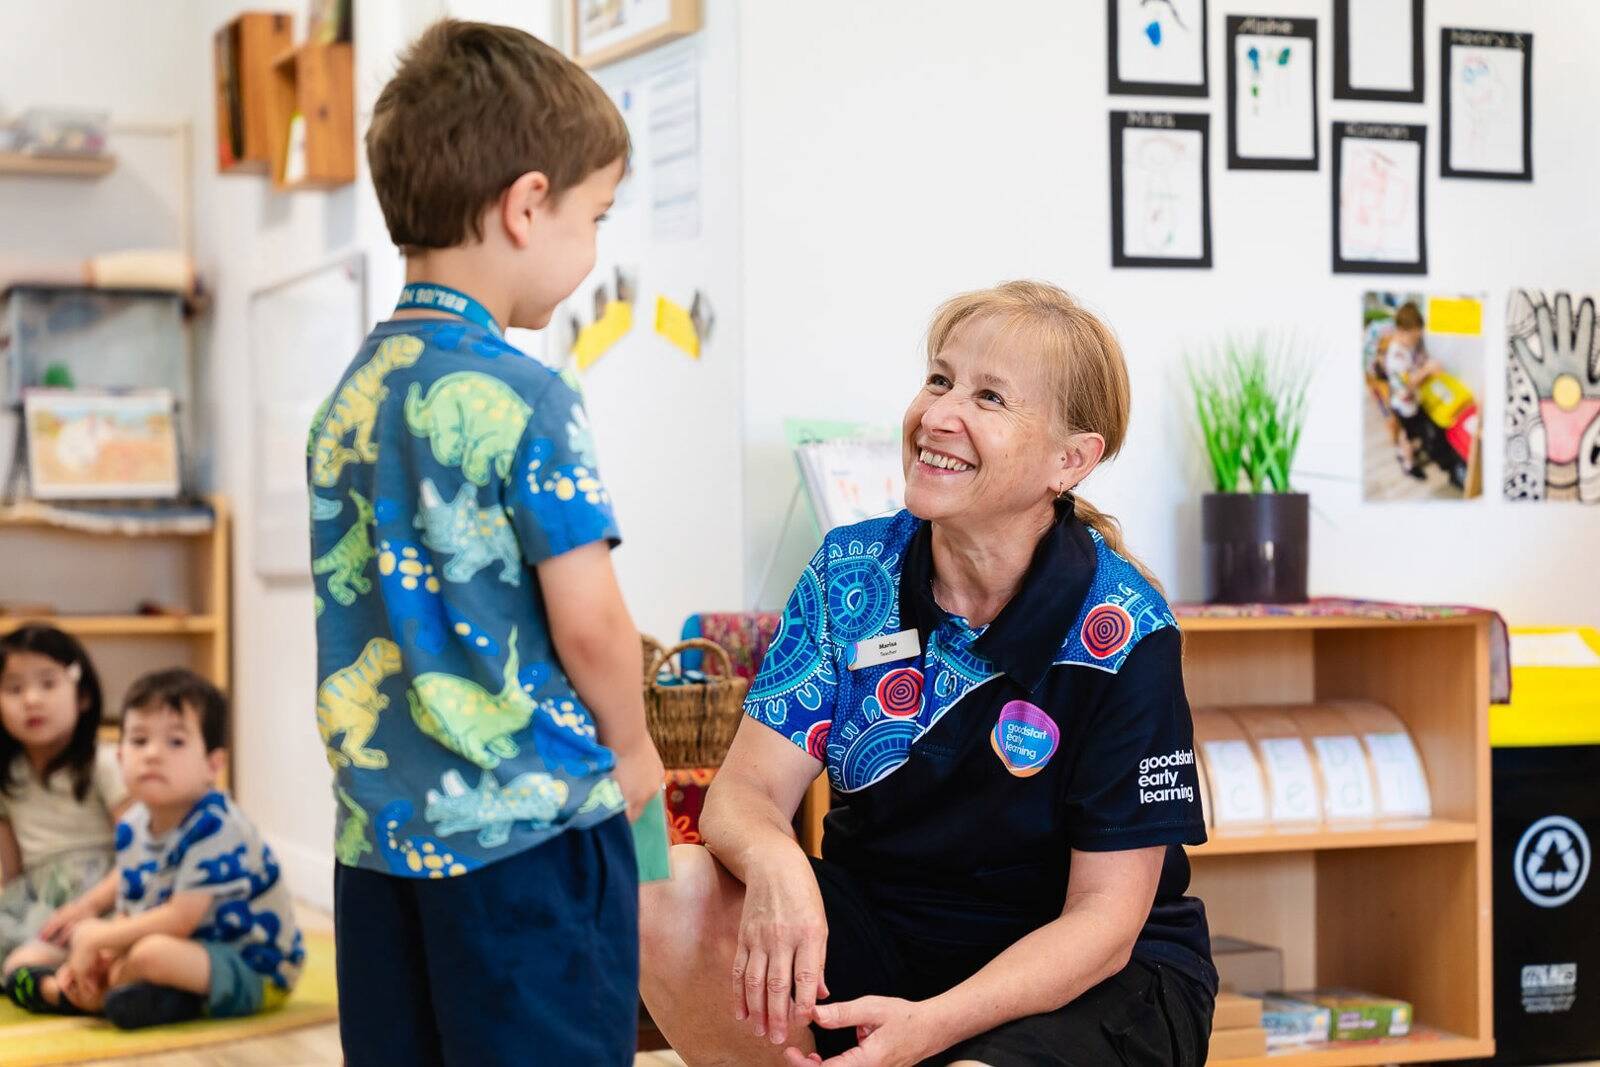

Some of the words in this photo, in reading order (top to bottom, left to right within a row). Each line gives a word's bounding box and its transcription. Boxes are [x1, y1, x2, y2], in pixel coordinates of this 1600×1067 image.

[879, 641, 897, 649] Marisa
[1006, 733, 1024, 745] early
[1007, 723, 1047, 740] goodstart
[1005, 742, 1037, 760] learning
[1139, 749, 1194, 774] goodstart
[1138, 769, 1179, 787] early
[1140, 784, 1194, 805] learning
